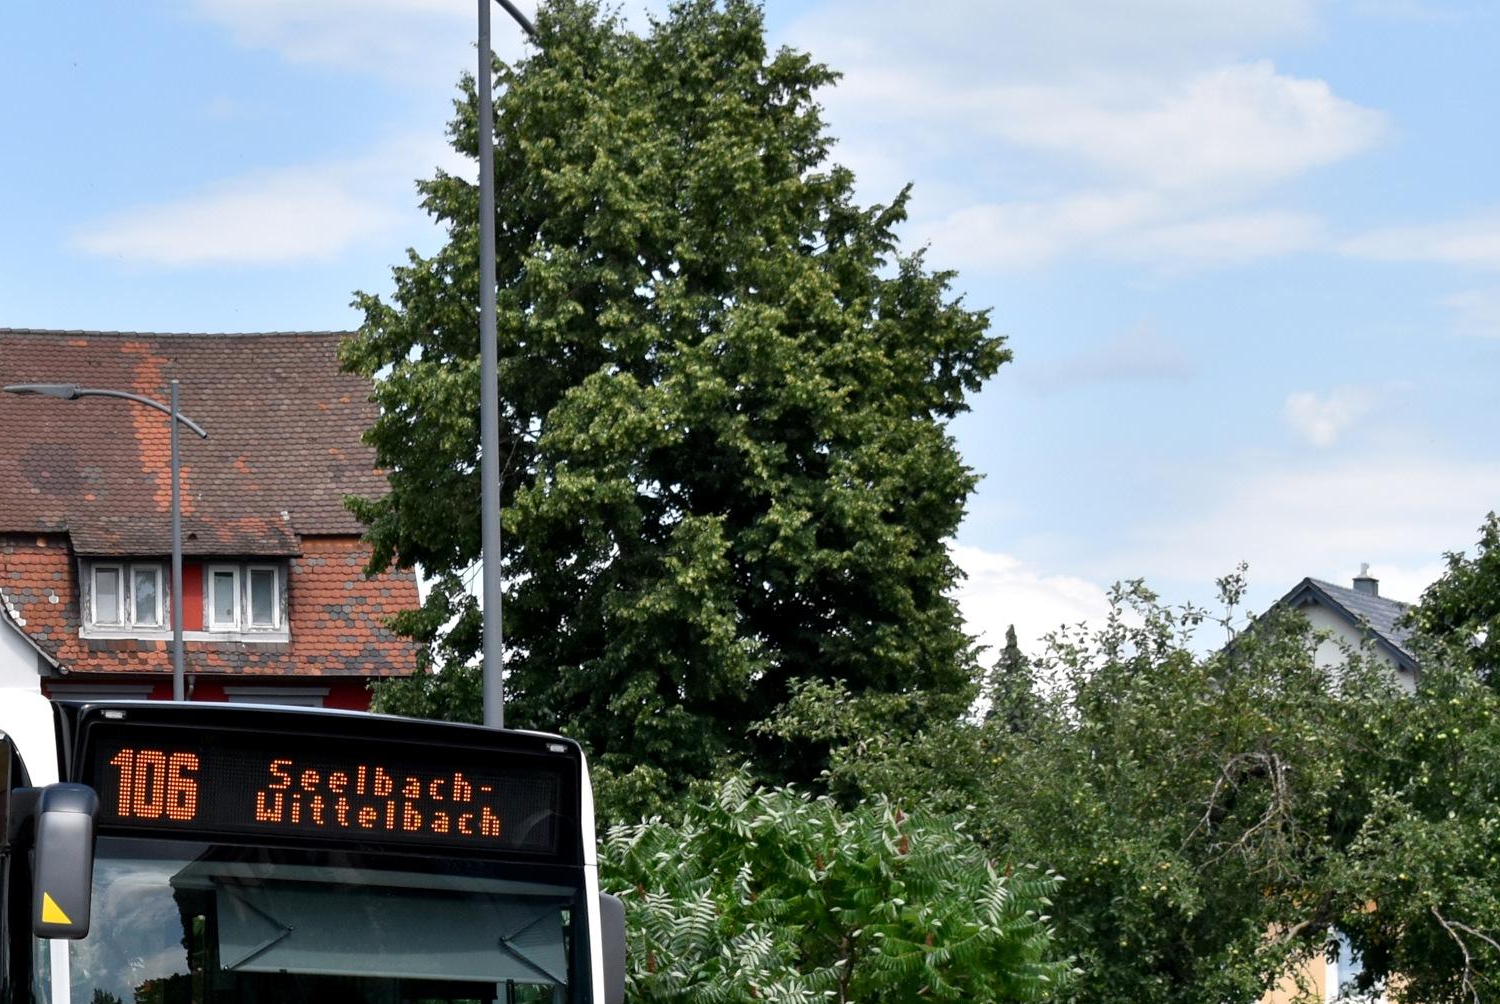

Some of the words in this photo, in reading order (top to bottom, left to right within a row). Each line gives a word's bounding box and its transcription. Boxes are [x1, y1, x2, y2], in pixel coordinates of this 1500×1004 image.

[110, 748, 199, 821] 106
[268, 759, 493, 803] Seelbach-
[255, 790, 501, 837] Wittelbach
